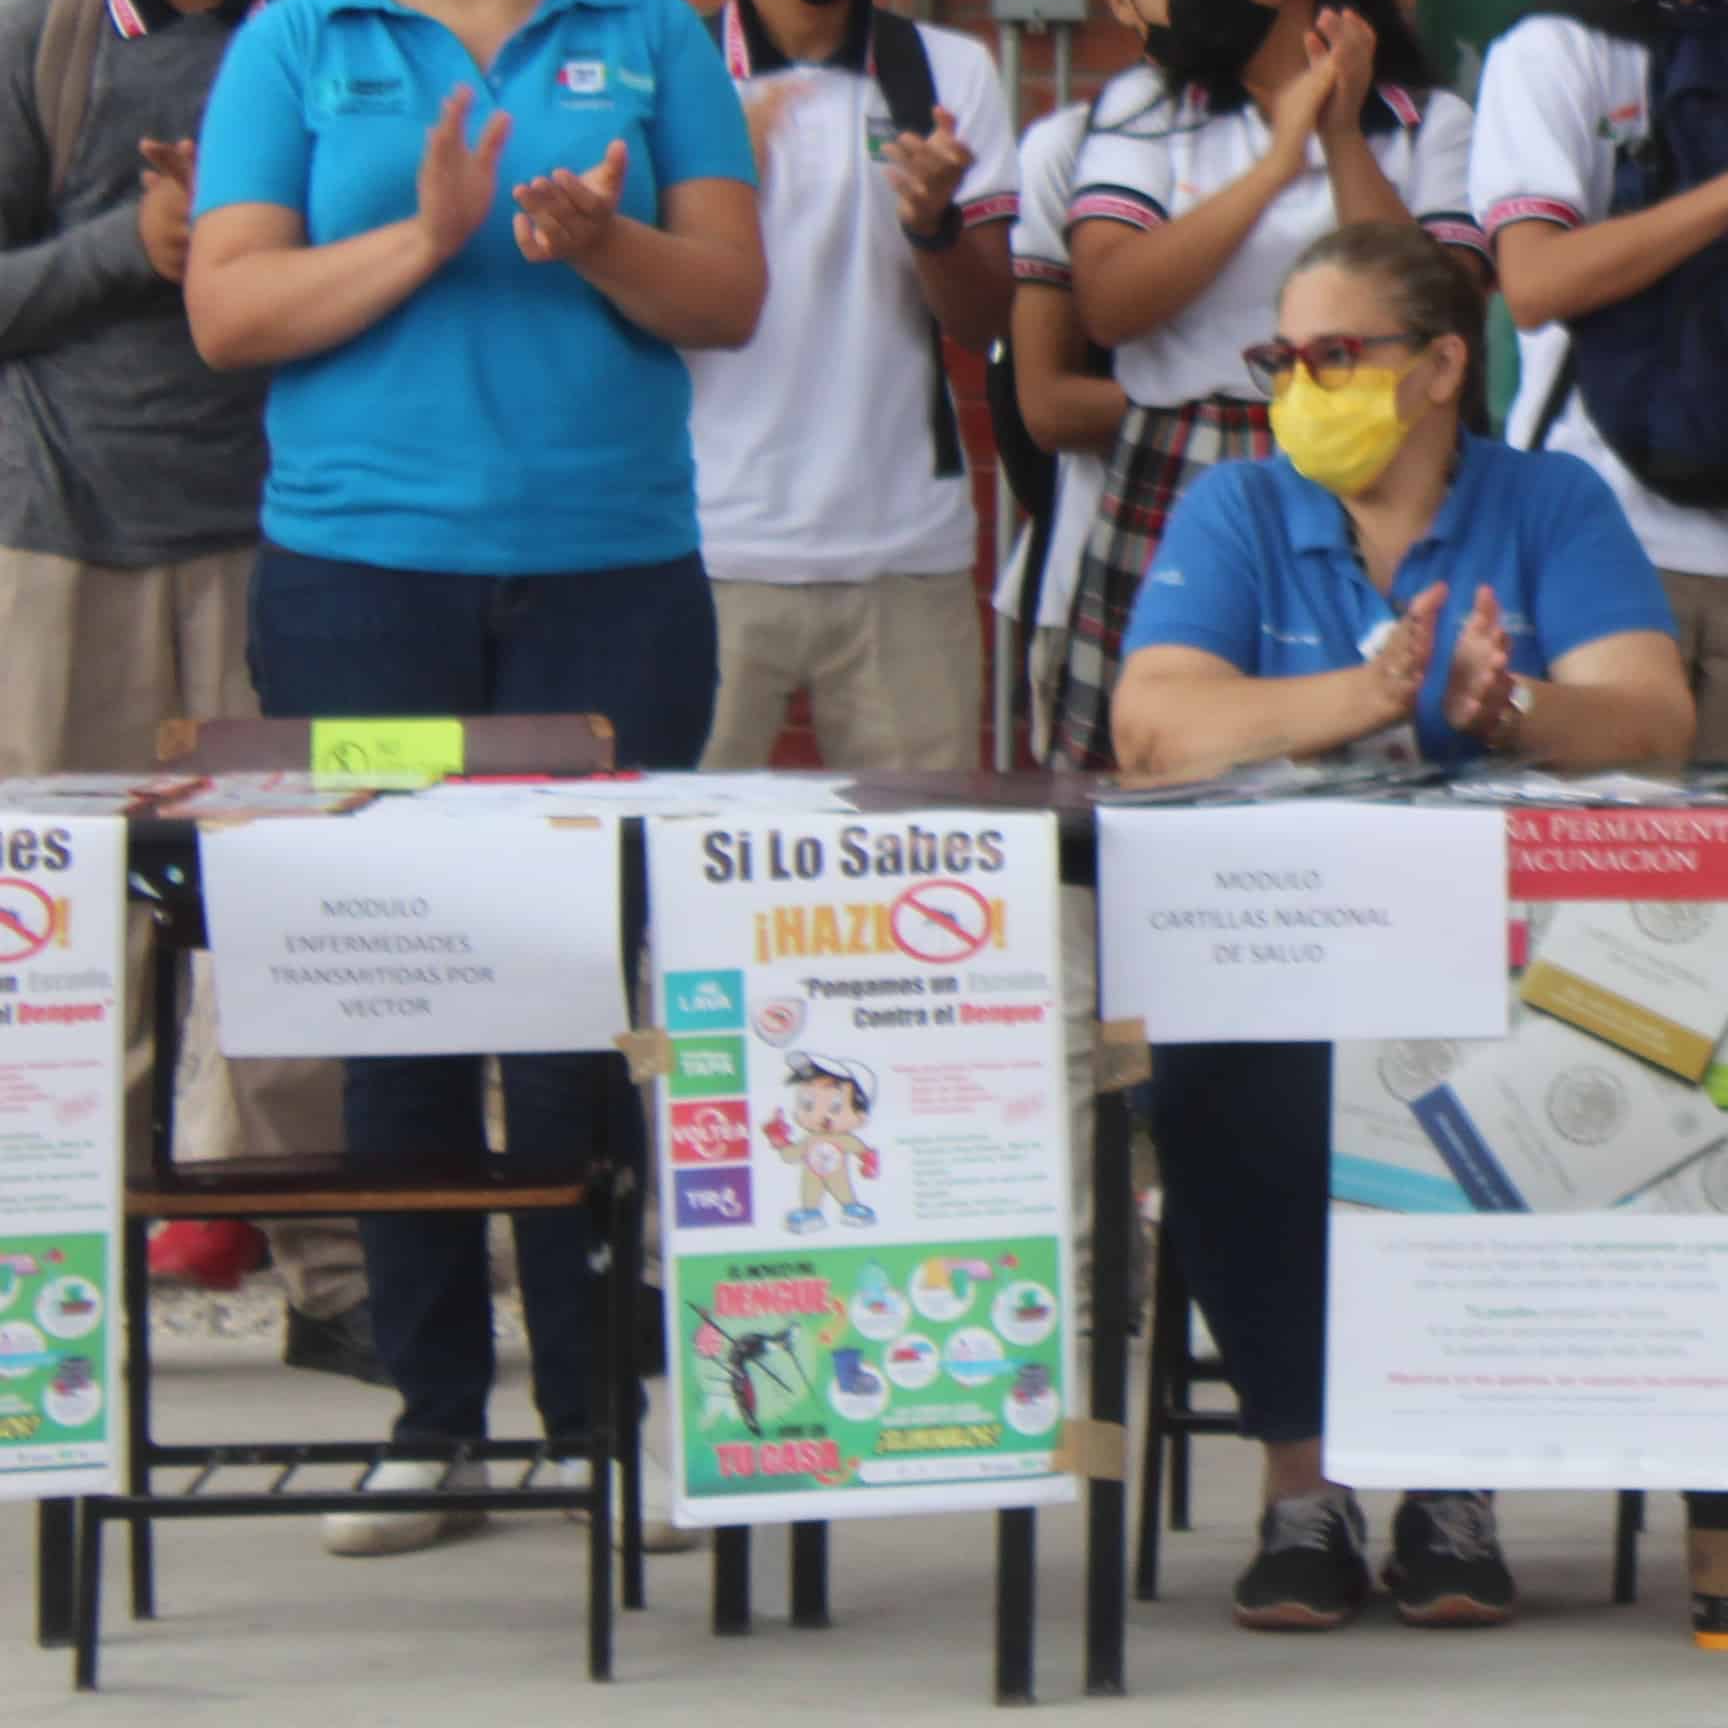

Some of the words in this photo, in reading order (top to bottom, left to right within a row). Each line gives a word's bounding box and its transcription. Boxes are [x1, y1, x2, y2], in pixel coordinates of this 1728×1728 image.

[703, 829, 753, 884] Si
[767, 829, 826, 881] Lo
[838, 825, 1005, 878] Sabes
[1148, 908, 1268, 931] CARTILLAS
[1272, 906, 1393, 930] NACIONAL
[285, 934, 472, 954] ENFERMEDADES
[1213, 943, 1243, 965] DE
[1250, 942, 1326, 965] SALUD
[446, 966, 496, 984] POR
[338, 998, 432, 1018] VECTOR
[853, 1005, 927, 1030] Contra
[714, 1442, 754, 1478] TU
[758, 1438, 842, 1476] CASA
